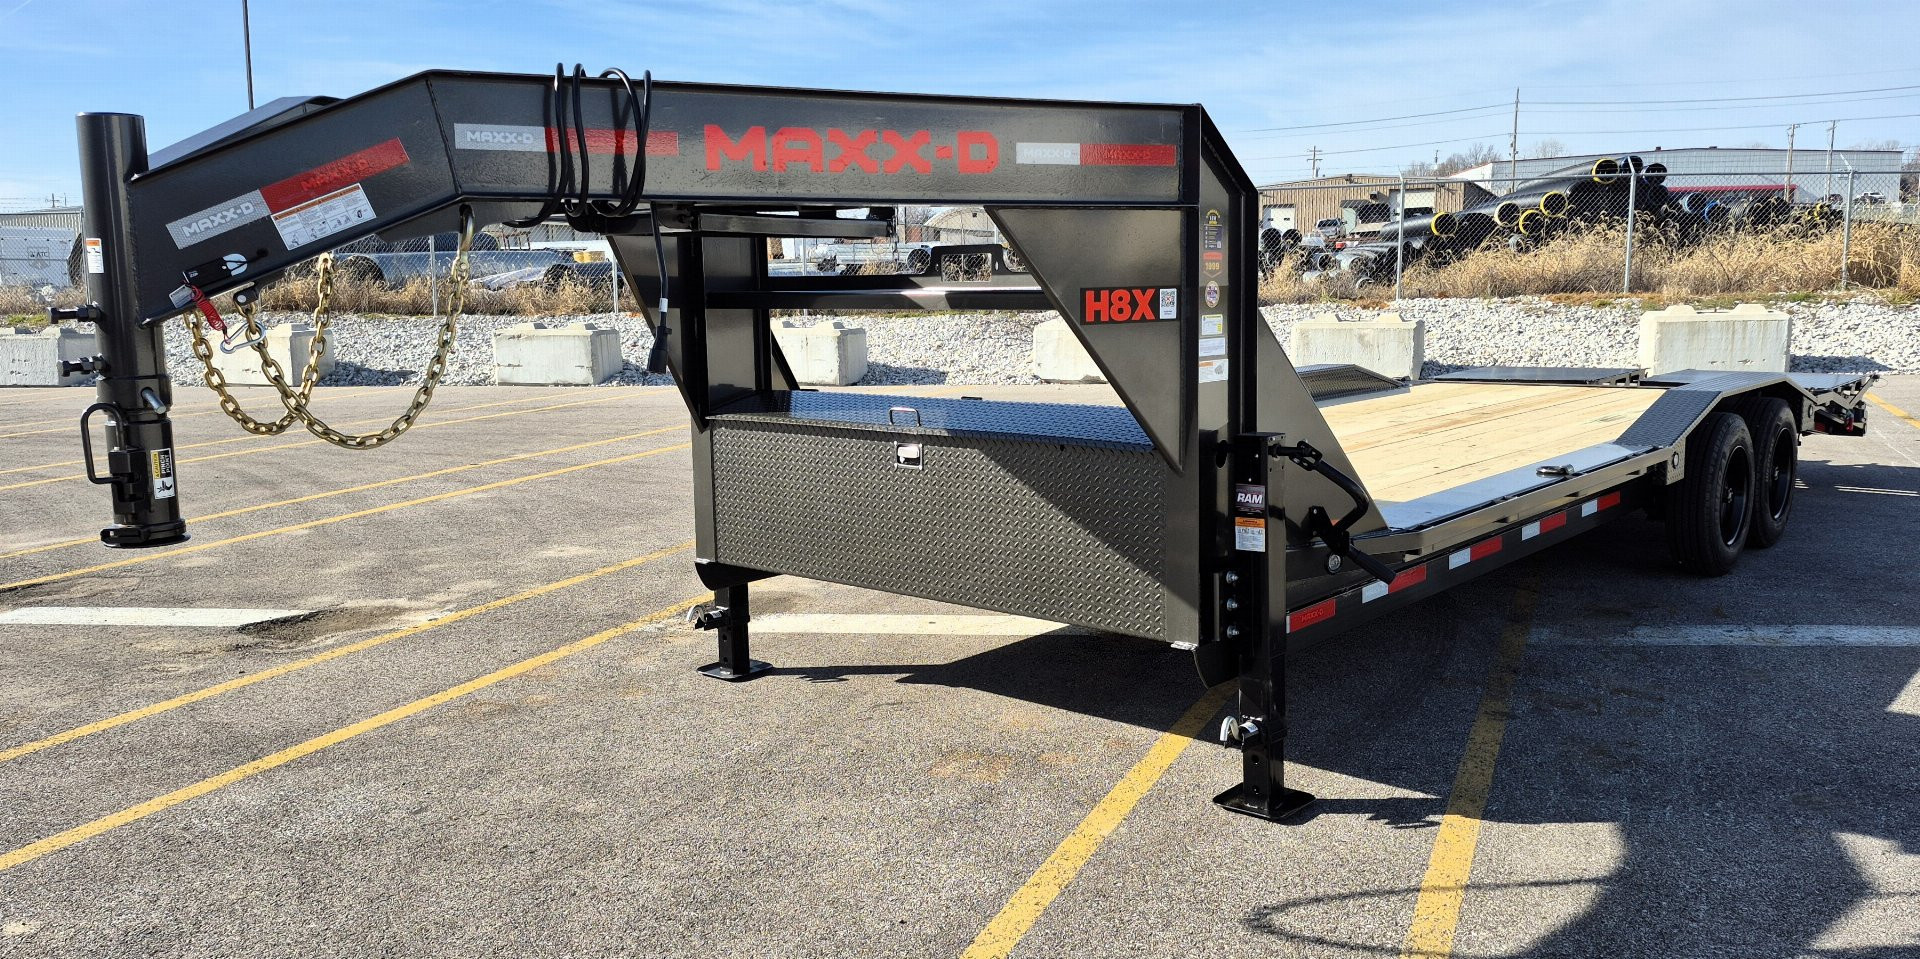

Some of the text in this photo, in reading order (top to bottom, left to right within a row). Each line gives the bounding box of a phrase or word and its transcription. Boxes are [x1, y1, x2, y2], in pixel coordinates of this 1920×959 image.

[466, 130, 534, 145] MAXX-D
[704, 124, 999, 175] MAXX-D
[181, 202, 255, 238] MAXX-D
[1085, 288, 1156, 323] H8X
[1237, 492, 1263, 504] RAM
